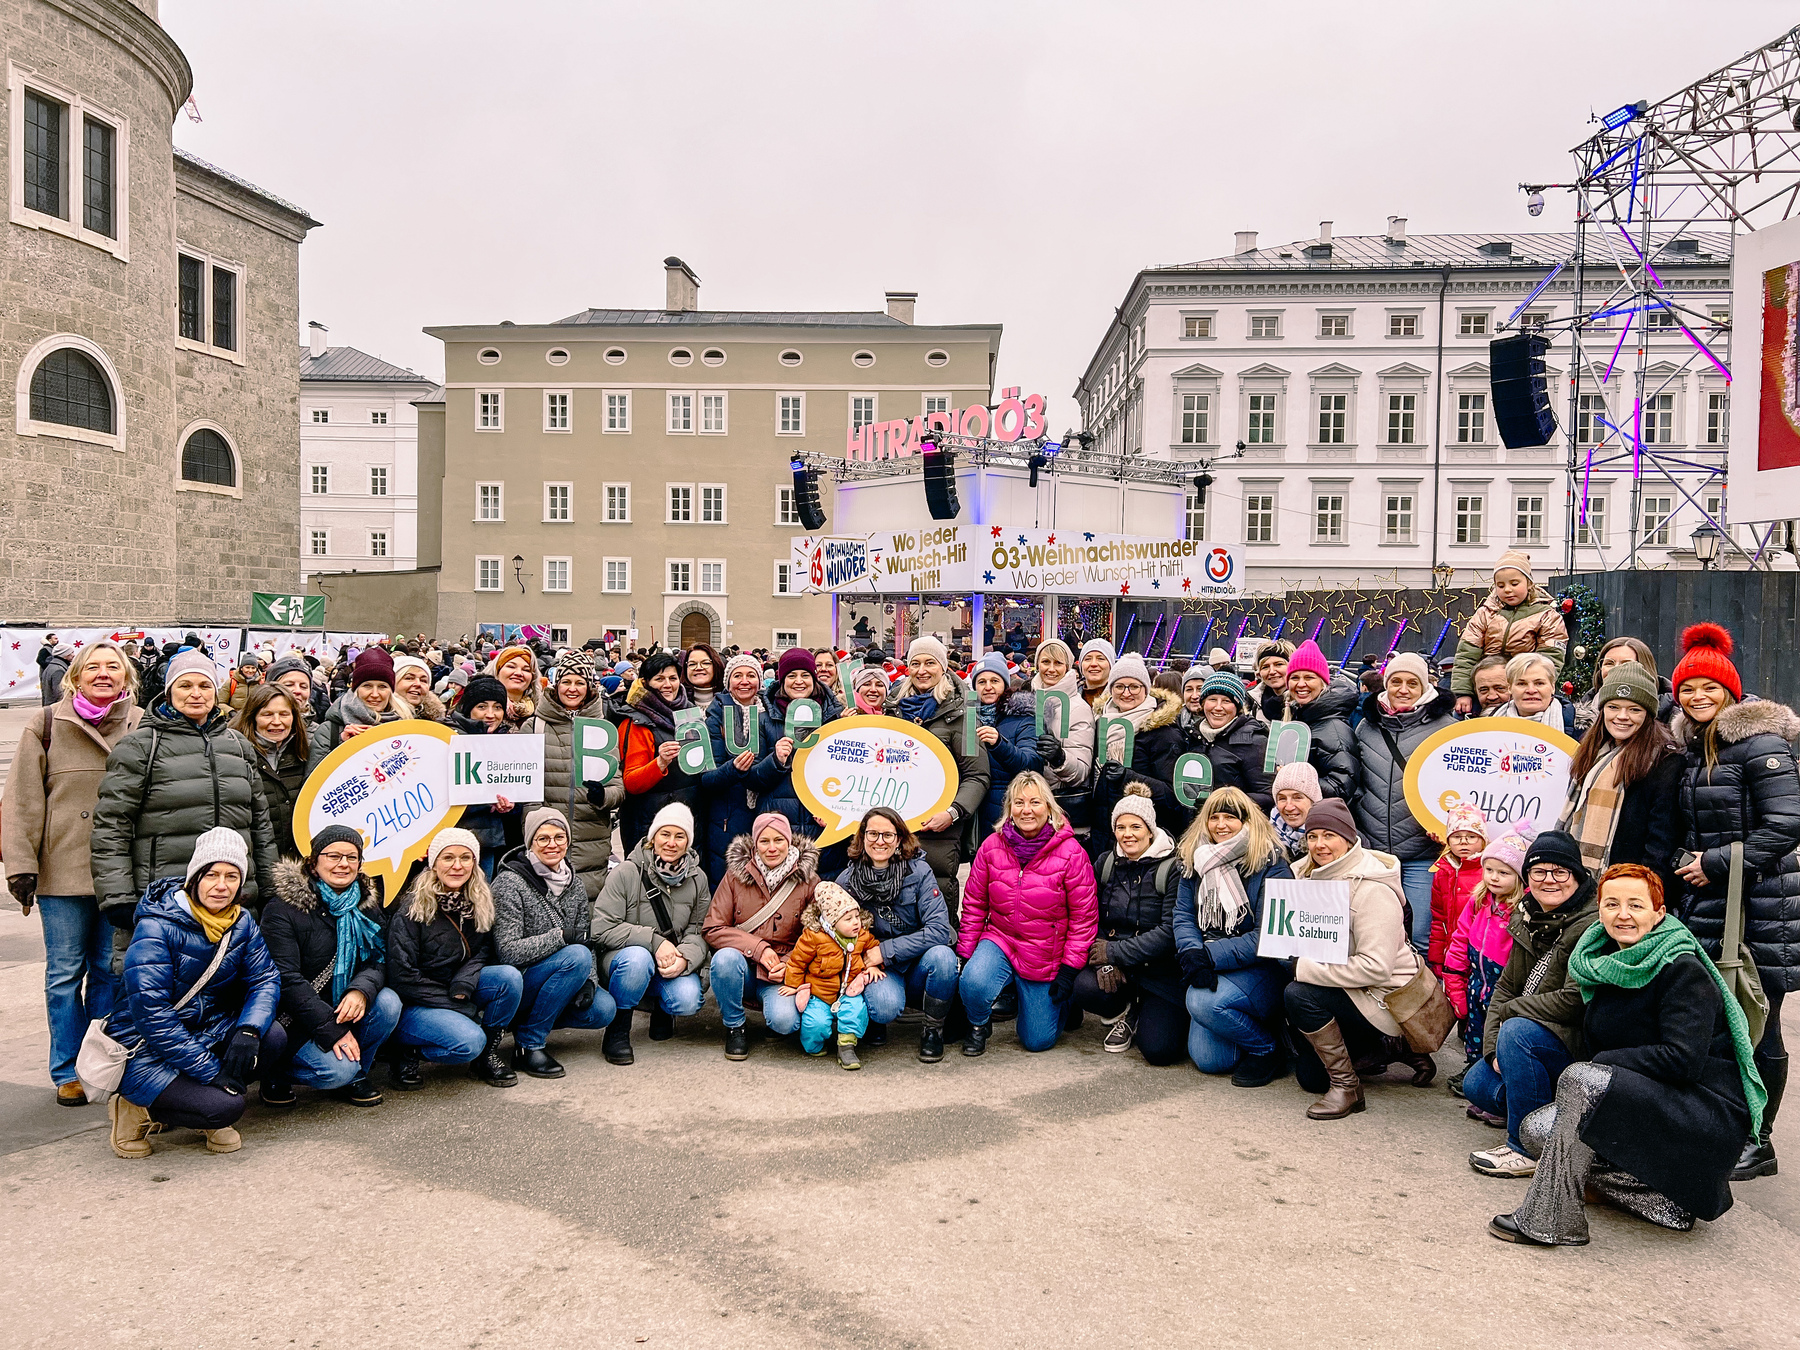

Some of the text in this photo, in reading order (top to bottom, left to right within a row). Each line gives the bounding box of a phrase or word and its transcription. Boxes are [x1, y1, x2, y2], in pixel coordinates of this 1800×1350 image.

[847, 386, 1048, 462] HITRADIO Ö3
[893, 526, 958, 553] Wo jeder
[825, 542, 865, 560] WEIHNACHTS
[886, 542, 967, 575] Wunsch-Hit
[991, 539, 1198, 570] Ö3-Weihnachtswunder
[826, 556, 866, 588] WUNDER
[911, 569, 941, 592] hilft!
[1011, 558, 1184, 592] Wo jeder Wunsch-Hit hilft!
[827, 745, 869, 757] SPENDE
[834, 739, 866, 748] UNSERE
[1450, 746, 1488, 756] UNSERE
[486, 760, 538, 771] Bäuerinnen
[830, 752, 864, 763] FÜR DAS
[1442, 753, 1492, 766] SPENDE
[1447, 762, 1487, 774] FÜR DAS
[1512, 761, 1542, 773] WUNDER
[486, 773, 532, 785] Salzburg
[322, 780, 369, 813] SPENDE
[323, 776, 359, 801] UNSERE
[332, 790, 369, 817] FÜR DAS
[1299, 910, 1344, 925] Bäuerinnen
[1298, 925, 1338, 943] Salzburg
